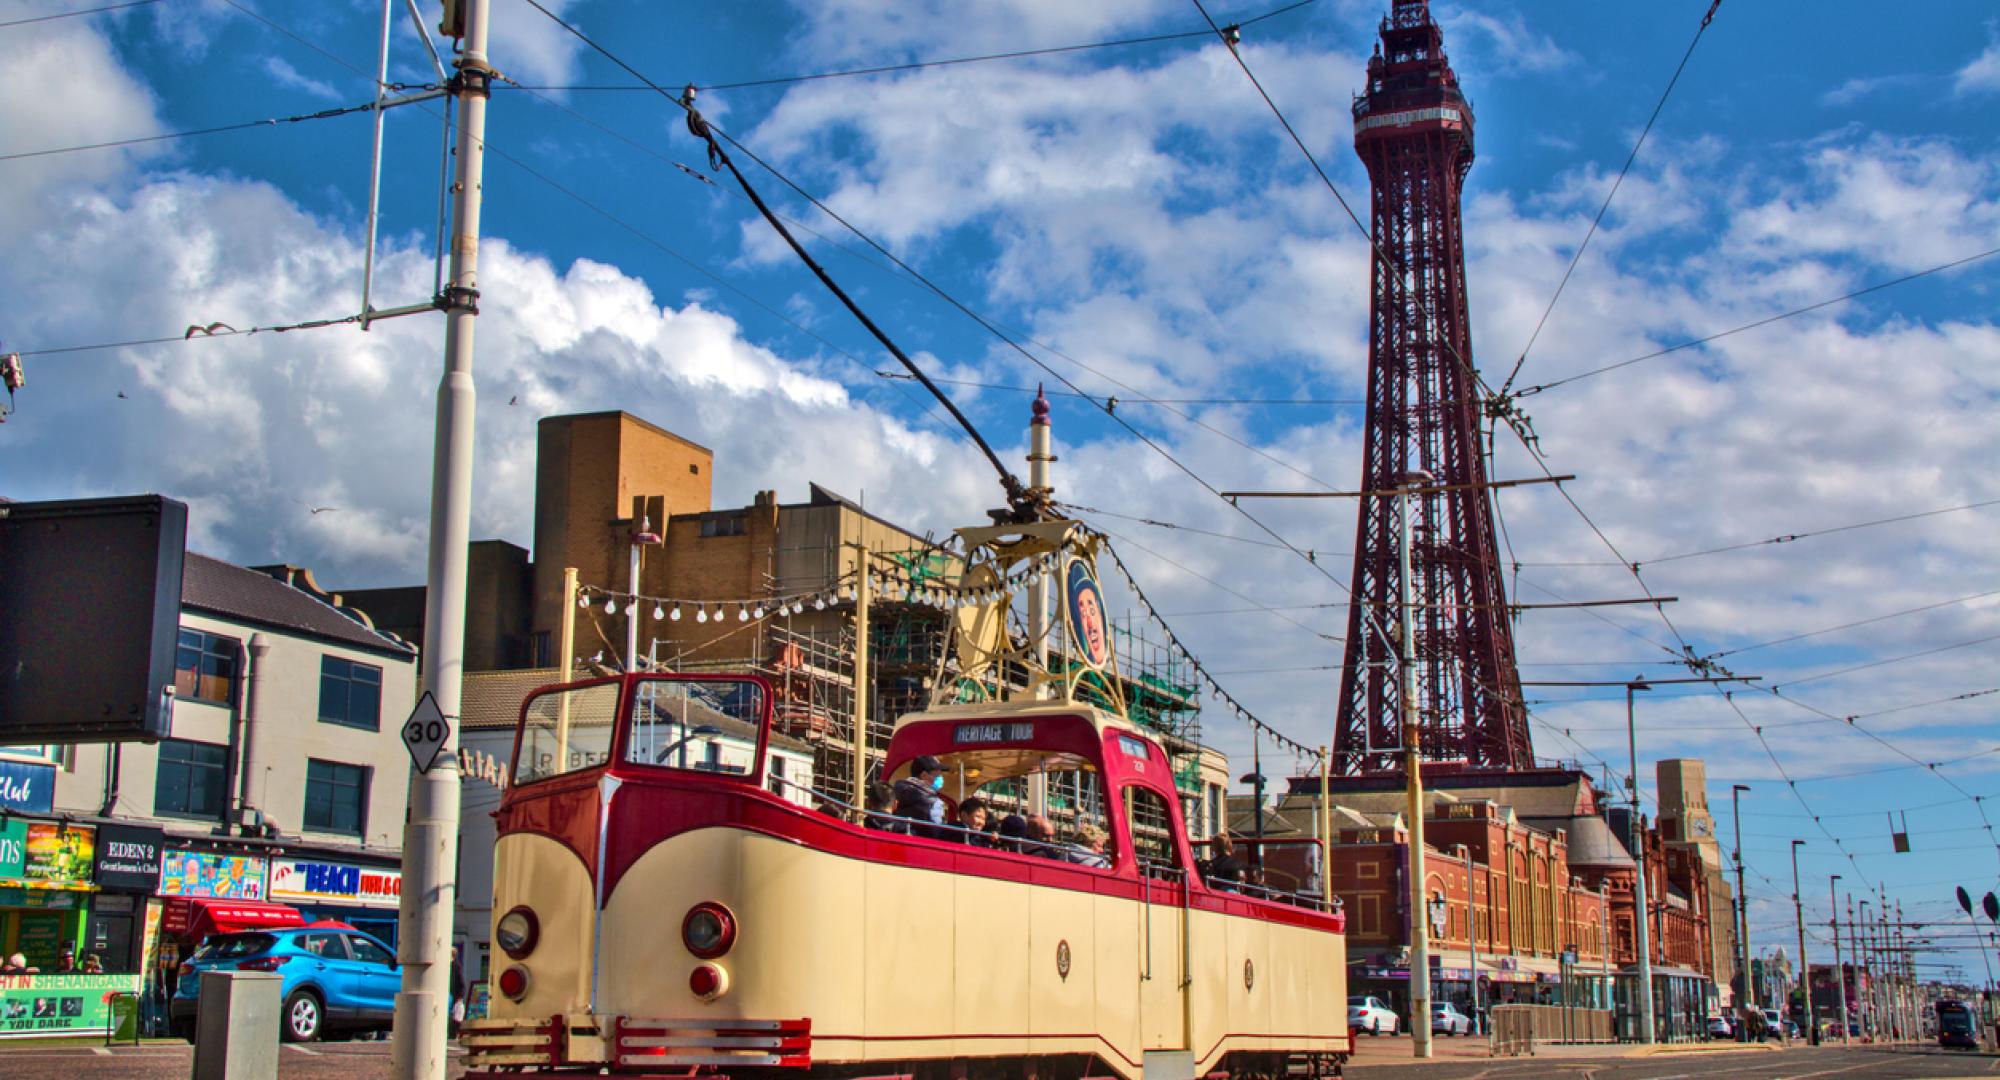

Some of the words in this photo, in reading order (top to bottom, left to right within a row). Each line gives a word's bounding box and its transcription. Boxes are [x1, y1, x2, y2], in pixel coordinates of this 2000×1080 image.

[409, 721, 442, 743] 30
[957, 724, 1002, 743] HERITAGE
[1011, 722, 1034, 741] TOUR
[107, 841, 147, 859] EDEN
[147, 845, 154, 860] 2
[100, 860, 141, 873] Gentlemen's
[143, 862, 159, 874] Club
[305, 864, 360, 895] BEACH
[18, 974, 31, 989] IN
[35, 974, 133, 990] SHENANIGANS
[9, 1019, 34, 1029] YOU
[38, 1018, 73, 1028] DARE
